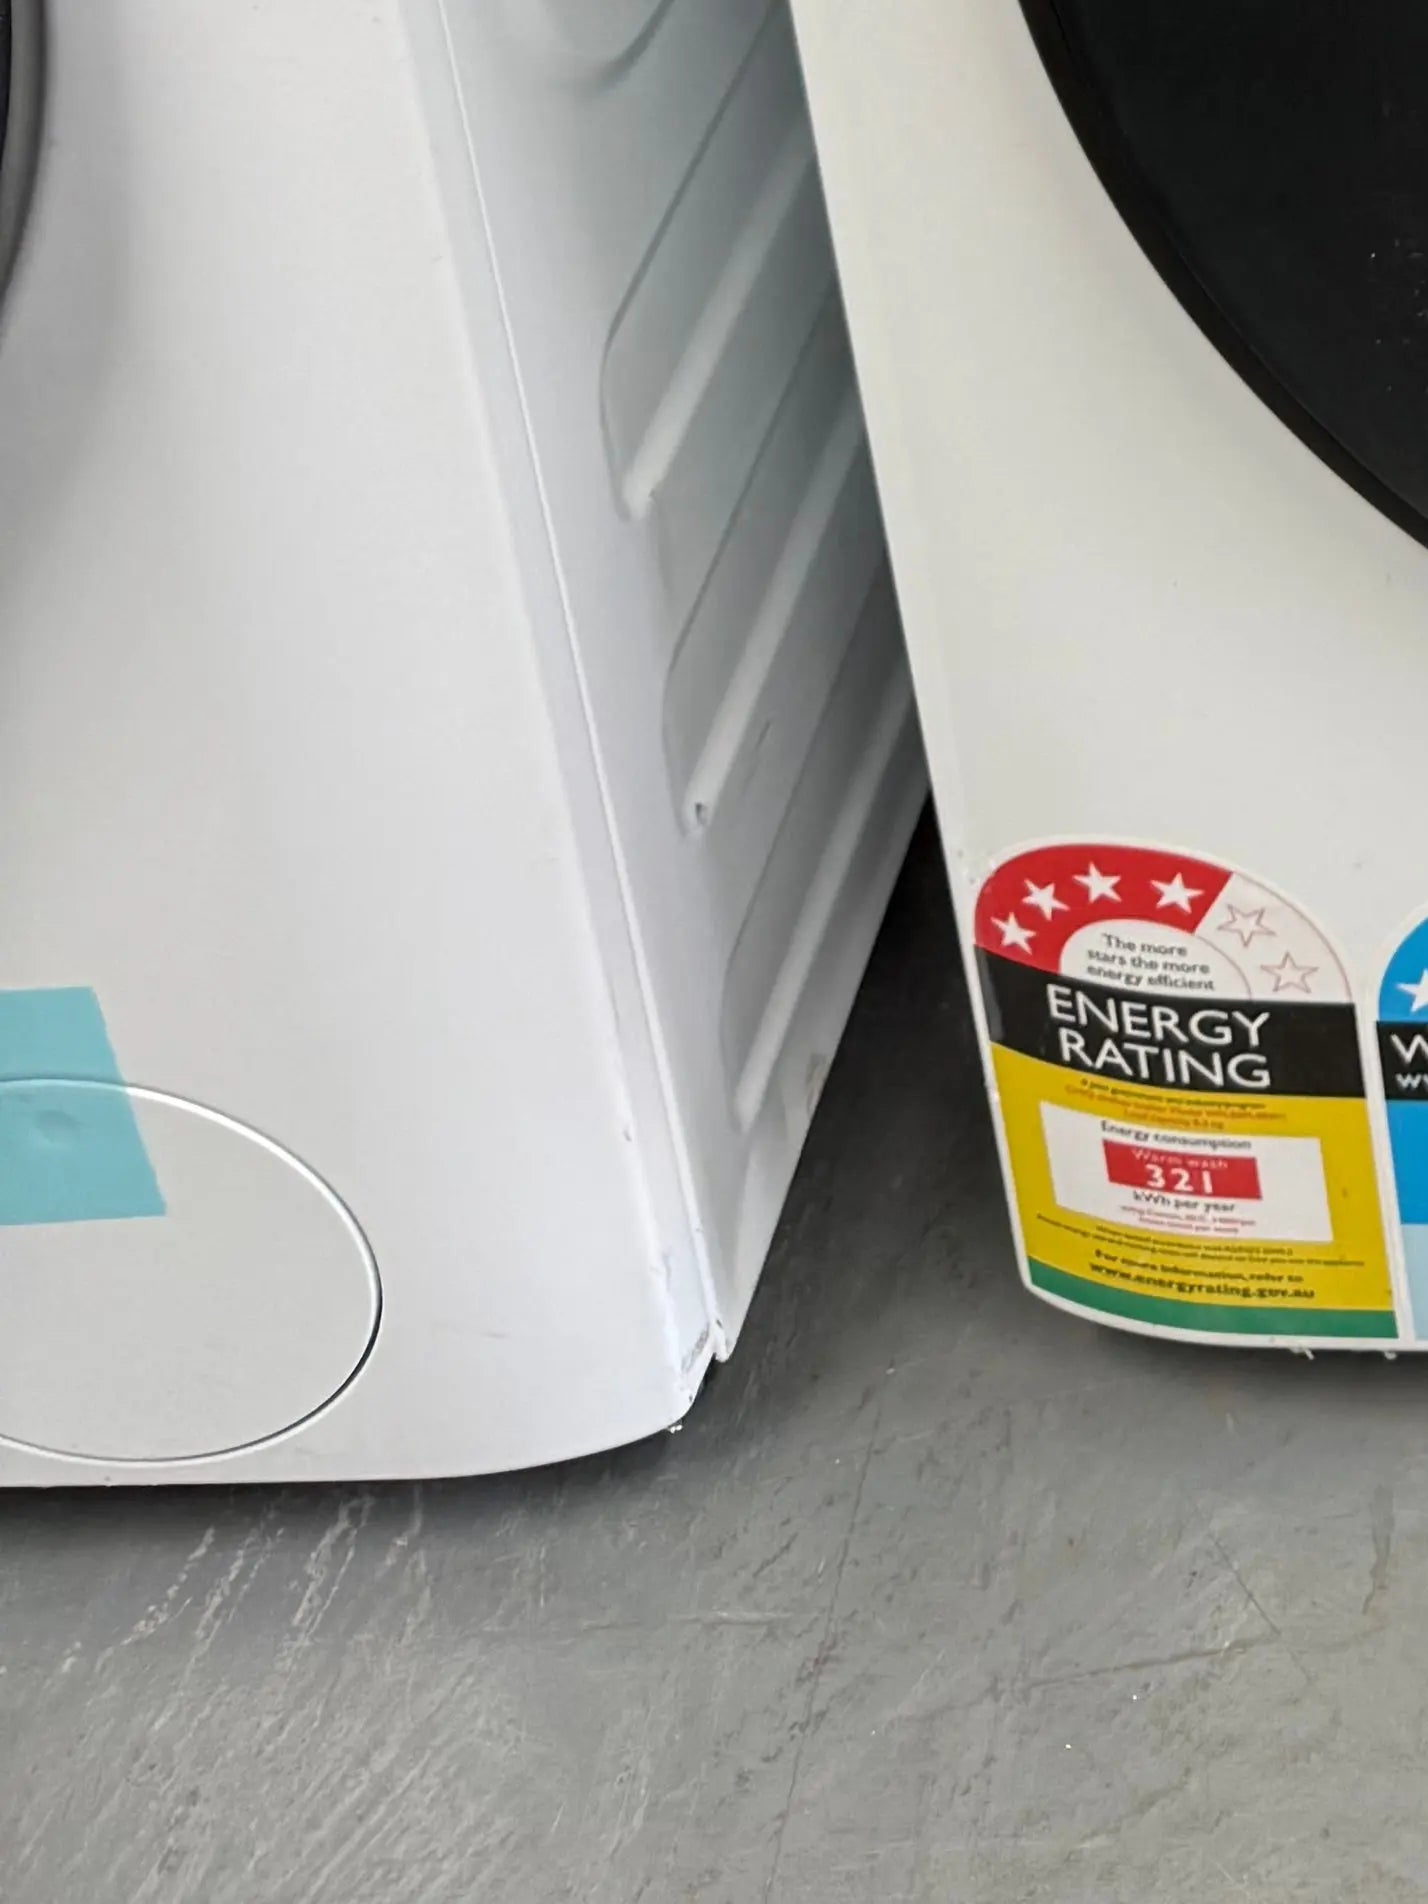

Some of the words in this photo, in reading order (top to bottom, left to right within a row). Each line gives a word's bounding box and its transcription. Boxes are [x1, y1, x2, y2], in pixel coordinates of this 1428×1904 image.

[1102, 932, 1137, 952] The
[1141, 942, 1188, 957] more
[1088, 949, 1127, 966] stars
[1131, 955, 1159, 971] the
[1163, 961, 1210, 974] more
[1087, 965, 1143, 987] energy
[1147, 974, 1214, 990] efficient
[1046, 983, 1271, 1048] ENERGY
[1058, 1026, 1272, 1089] RATING
[1101, 1120, 1151, 1142] Energy
[1145, 1164, 1214, 1195] 321
[1133, 1191, 1171, 1207] kWh
